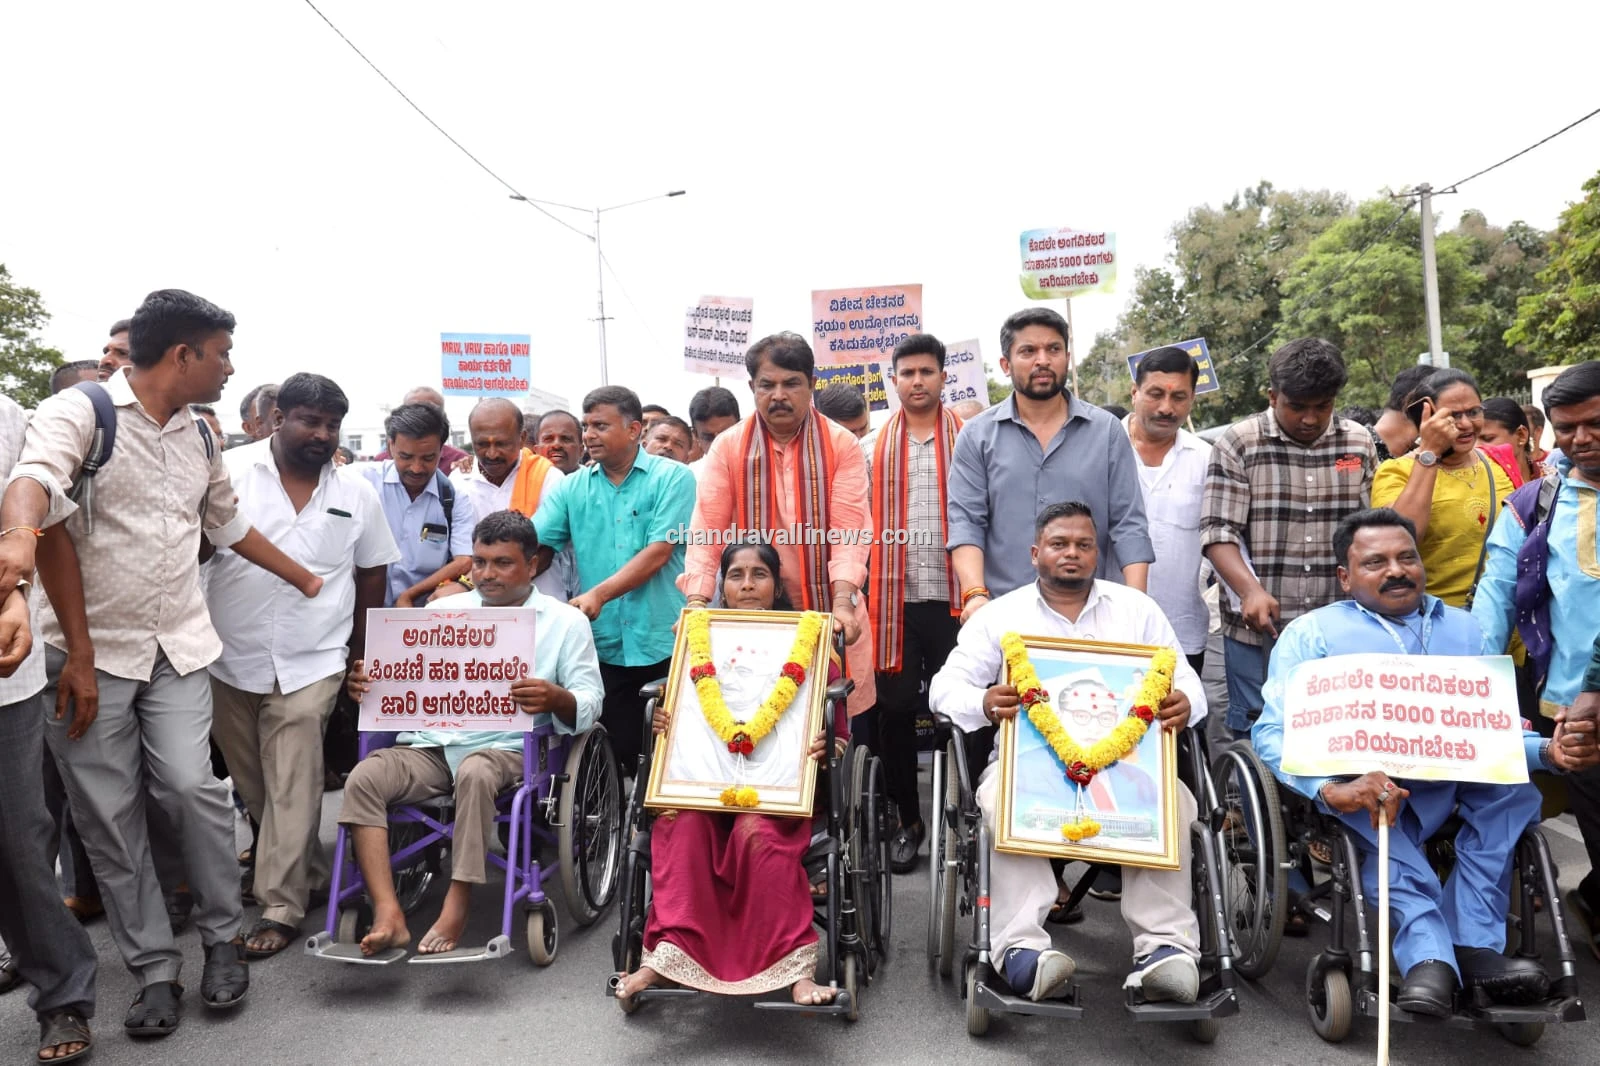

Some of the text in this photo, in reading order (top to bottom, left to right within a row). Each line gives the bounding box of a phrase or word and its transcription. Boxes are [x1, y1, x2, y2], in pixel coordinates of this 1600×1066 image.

[1057, 232, 1105, 249] ಅಂಗವಿಕಲರ
[1059, 255, 1082, 268] 5000
[1039, 271, 1099, 288] ಜಾರಿಯಾಗಬೇಕು
[829, 294, 905, 313] ವಿಶೇಷ ಚೇತನರ
[814, 313, 921, 339] ಸ್ವಯಂ ಉದ್ಯೋಗವನ್ನು
[442, 341, 463, 356] MRW,
[464, 342, 481, 354] VRW
[510, 343, 530, 356] URW
[403, 624, 496, 647] ಅಂಗವಿಕಲರ
[369, 653, 529, 681] ಪಿಂಚಣಿ ಹಣ ಕೂಡಲೇ
[1379, 673, 1491, 698] ಅಂಗವಿಕಲರ
[381, 690, 517, 715] ಜಾರಿ ಆಗಲೇಬೇಕು
[1291, 700, 1512, 731] ಮಾಶಾಸನ 5000 ರೂಗಳು
[1328, 729, 1477, 761] ಜಾರಿಯಾಗಬೇಕು
